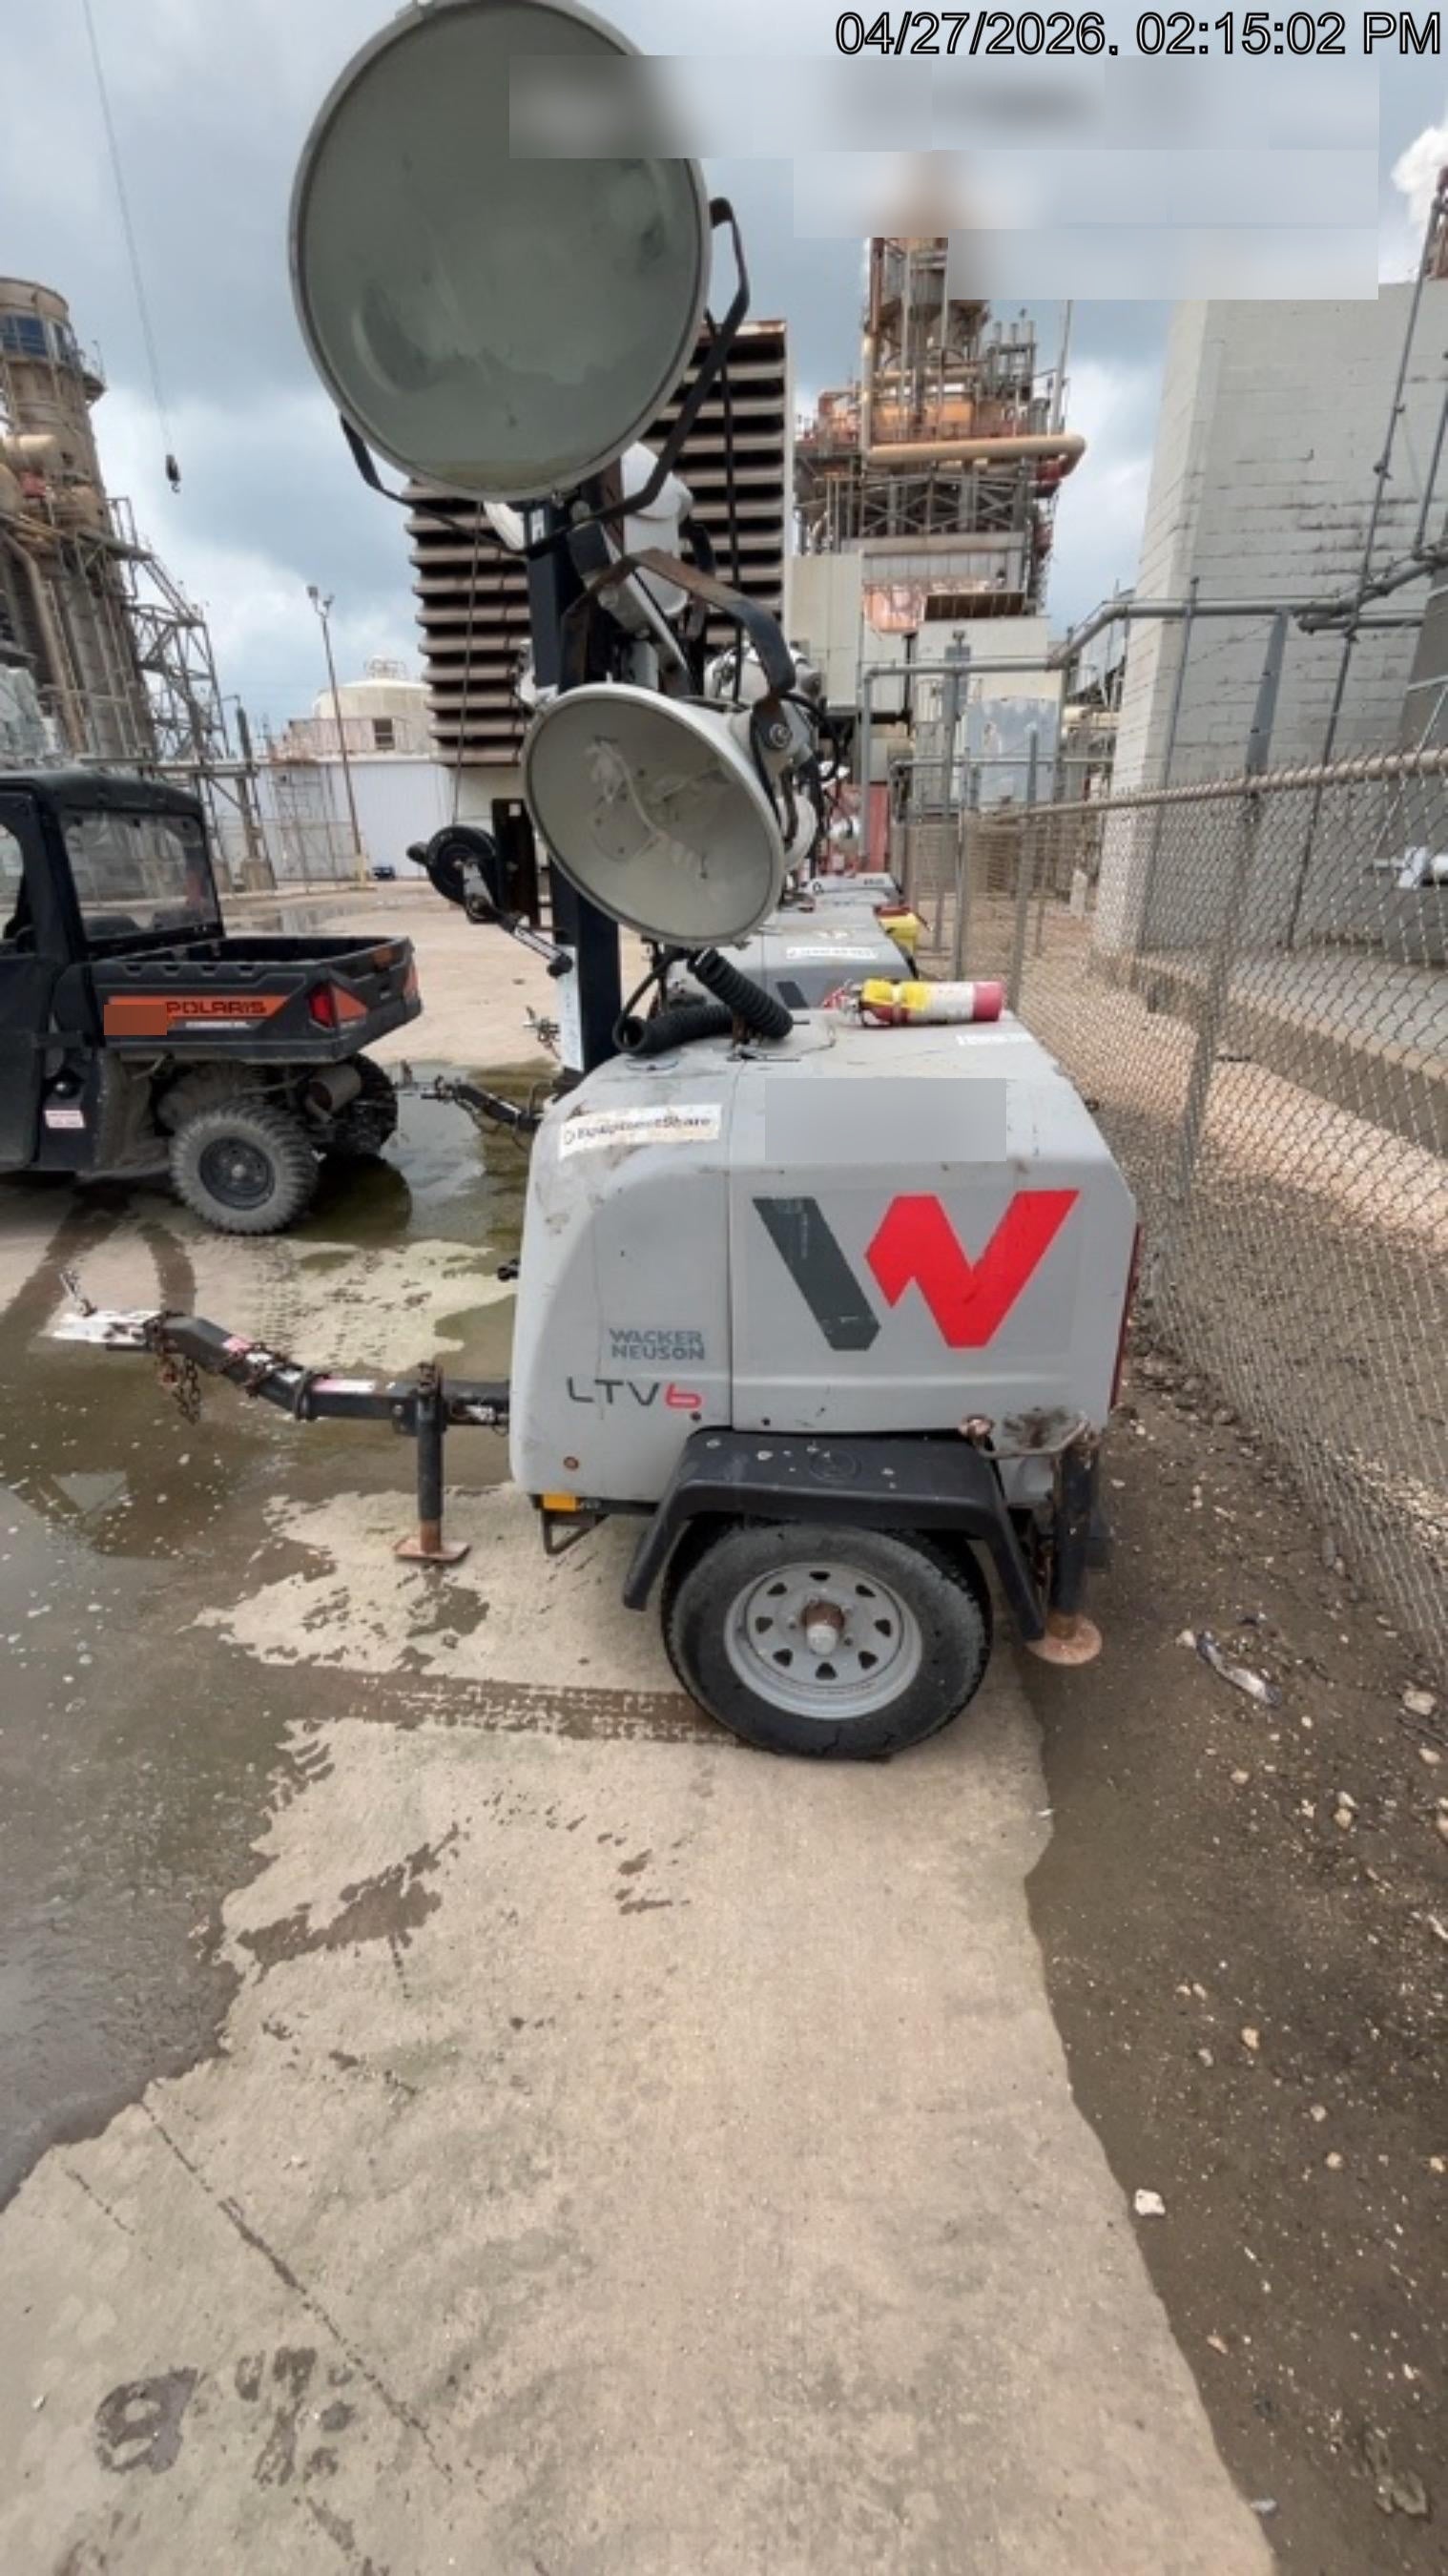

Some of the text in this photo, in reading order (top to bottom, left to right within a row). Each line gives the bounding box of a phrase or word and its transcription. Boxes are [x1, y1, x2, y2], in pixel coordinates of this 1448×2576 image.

[166, 1001, 267, 1014] POLARIS
[610, 1328, 703, 1344] WACKER
[610, 1343, 706, 1361] NEUSON
[566, 1376, 702, 1408] LTV6
